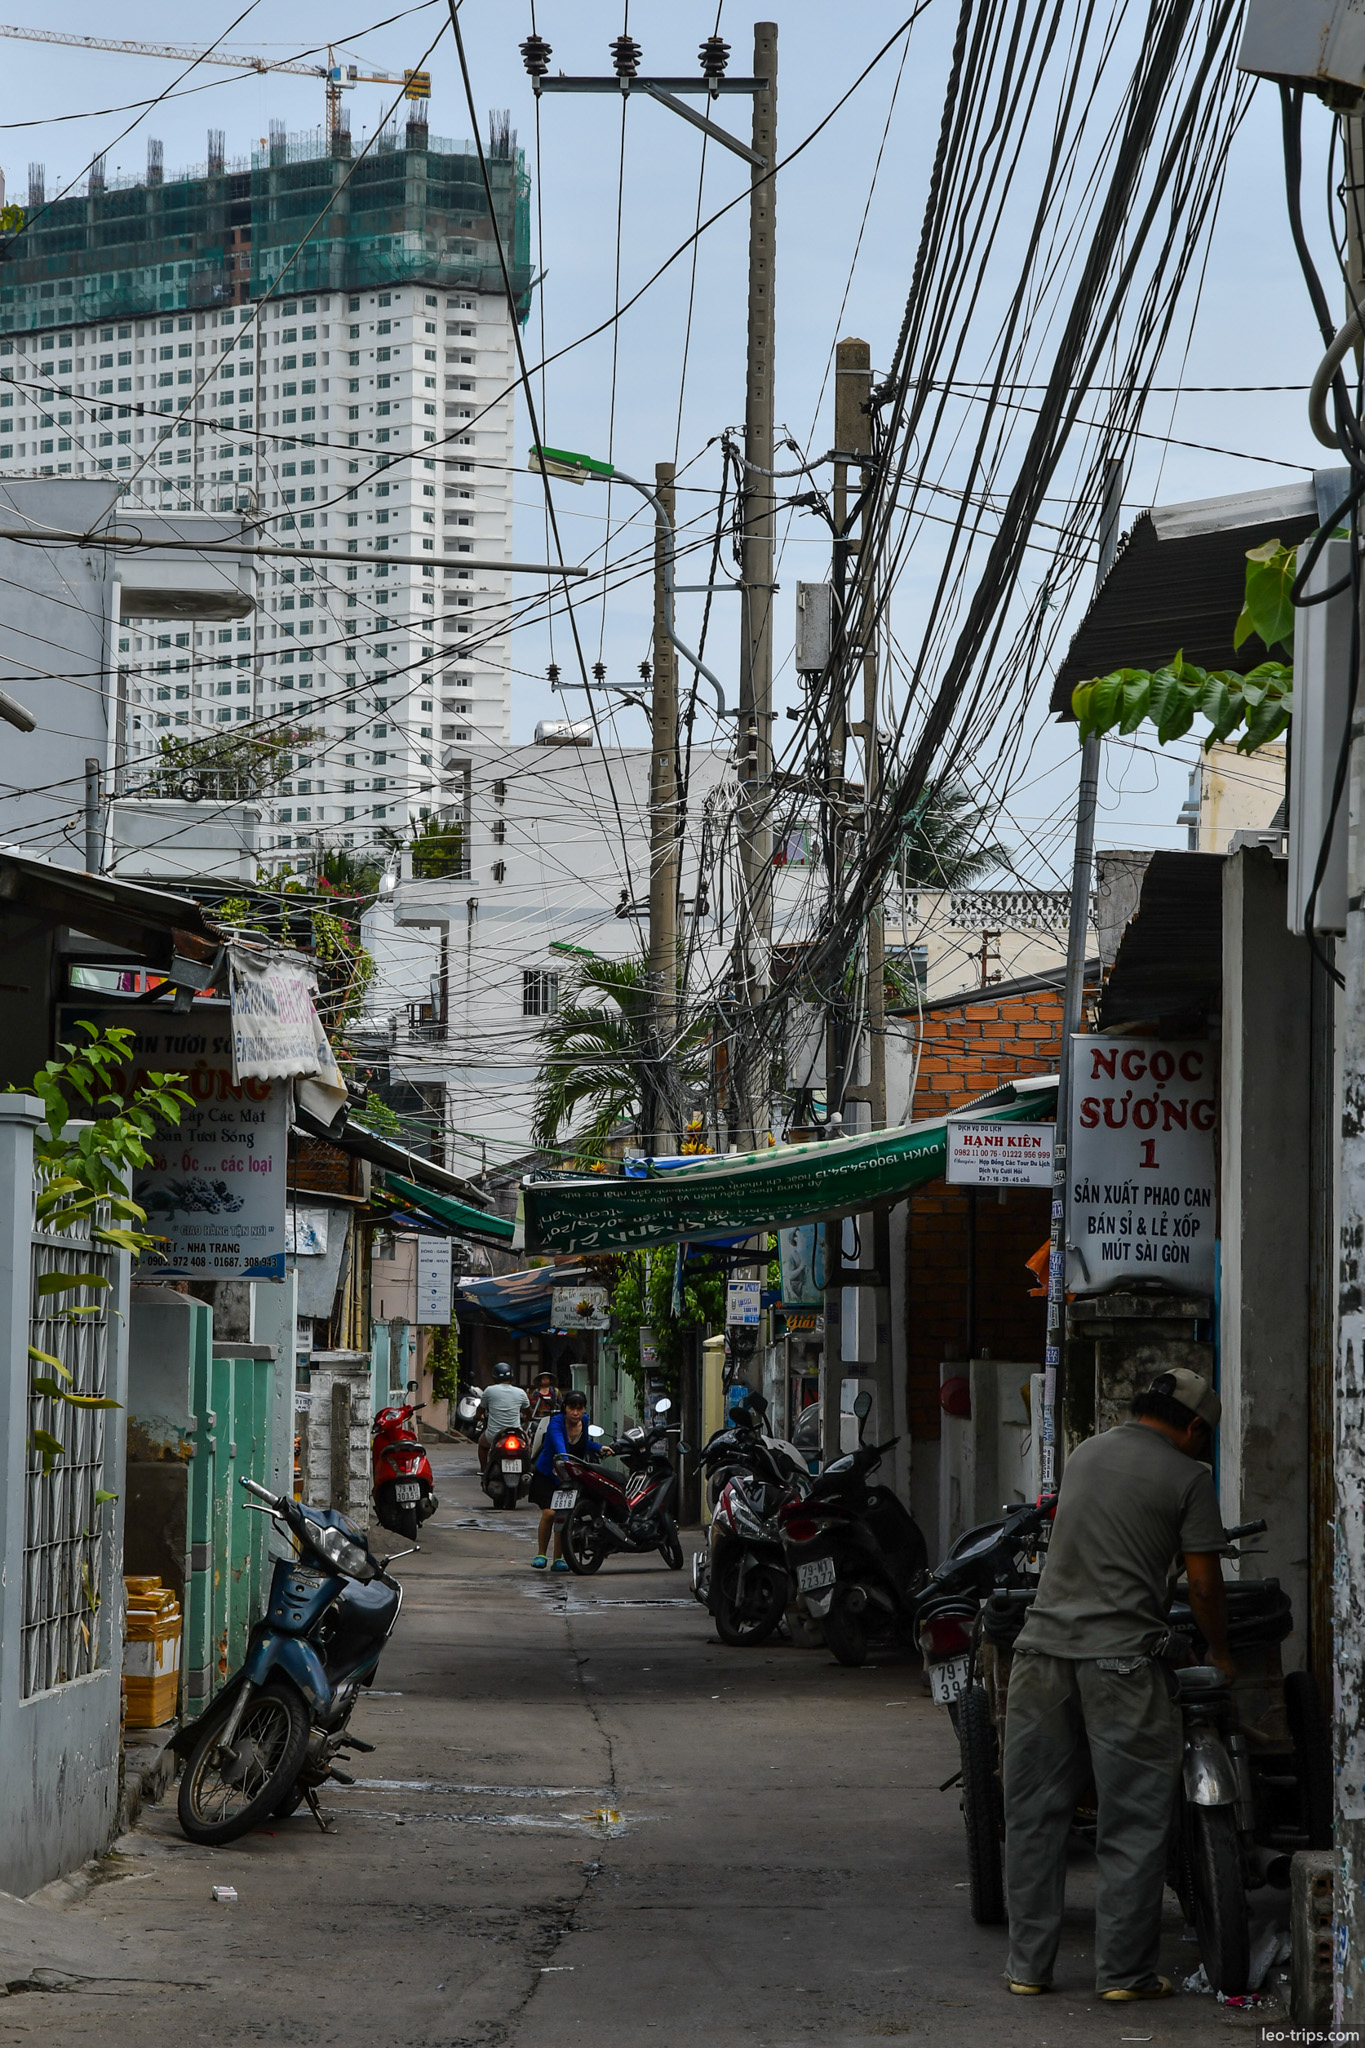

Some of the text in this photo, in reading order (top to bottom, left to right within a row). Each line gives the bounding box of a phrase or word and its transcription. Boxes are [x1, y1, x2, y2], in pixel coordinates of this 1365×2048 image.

[1090, 1048, 1203, 1090] NGỌC
[1080, 1089, 1216, 1132] SƯƠNG
[903, 1144, 939, 1161] DVKH
[964, 1134, 1042, 1148] HẠNH KIÊN
[1139, 1138, 1160, 1168] 1
[182, 1147, 199, 1172] Ốc
[222, 1153, 244, 1172] các
[249, 1154, 272, 1178] loại
[815, 1153, 900, 1180] 1900.54.54.13
[1074, 1177, 1211, 1207] SẢN XUẤT PHAO CAN
[180, 1226, 202, 1236] GIAO
[204, 1224, 228, 1236] HÀNG
[1087, 1210, 1200, 1238] BÁN SỈ & LẺ XỐP
[188, 1244, 206, 1252] NHA
[209, 1243, 240, 1253] TRANG
[1101, 1238, 1190, 1264] MÚT SÀI GÒN
[173, 1256, 188, 1266] 972
[190, 1256, 206, 1266] 408
[244, 1257, 259, 1267] 308
[262, 1257, 277, 1267] 943
[801, 1571, 833, 1590] 223.72
[940, 1680, 965, 1700] 39
